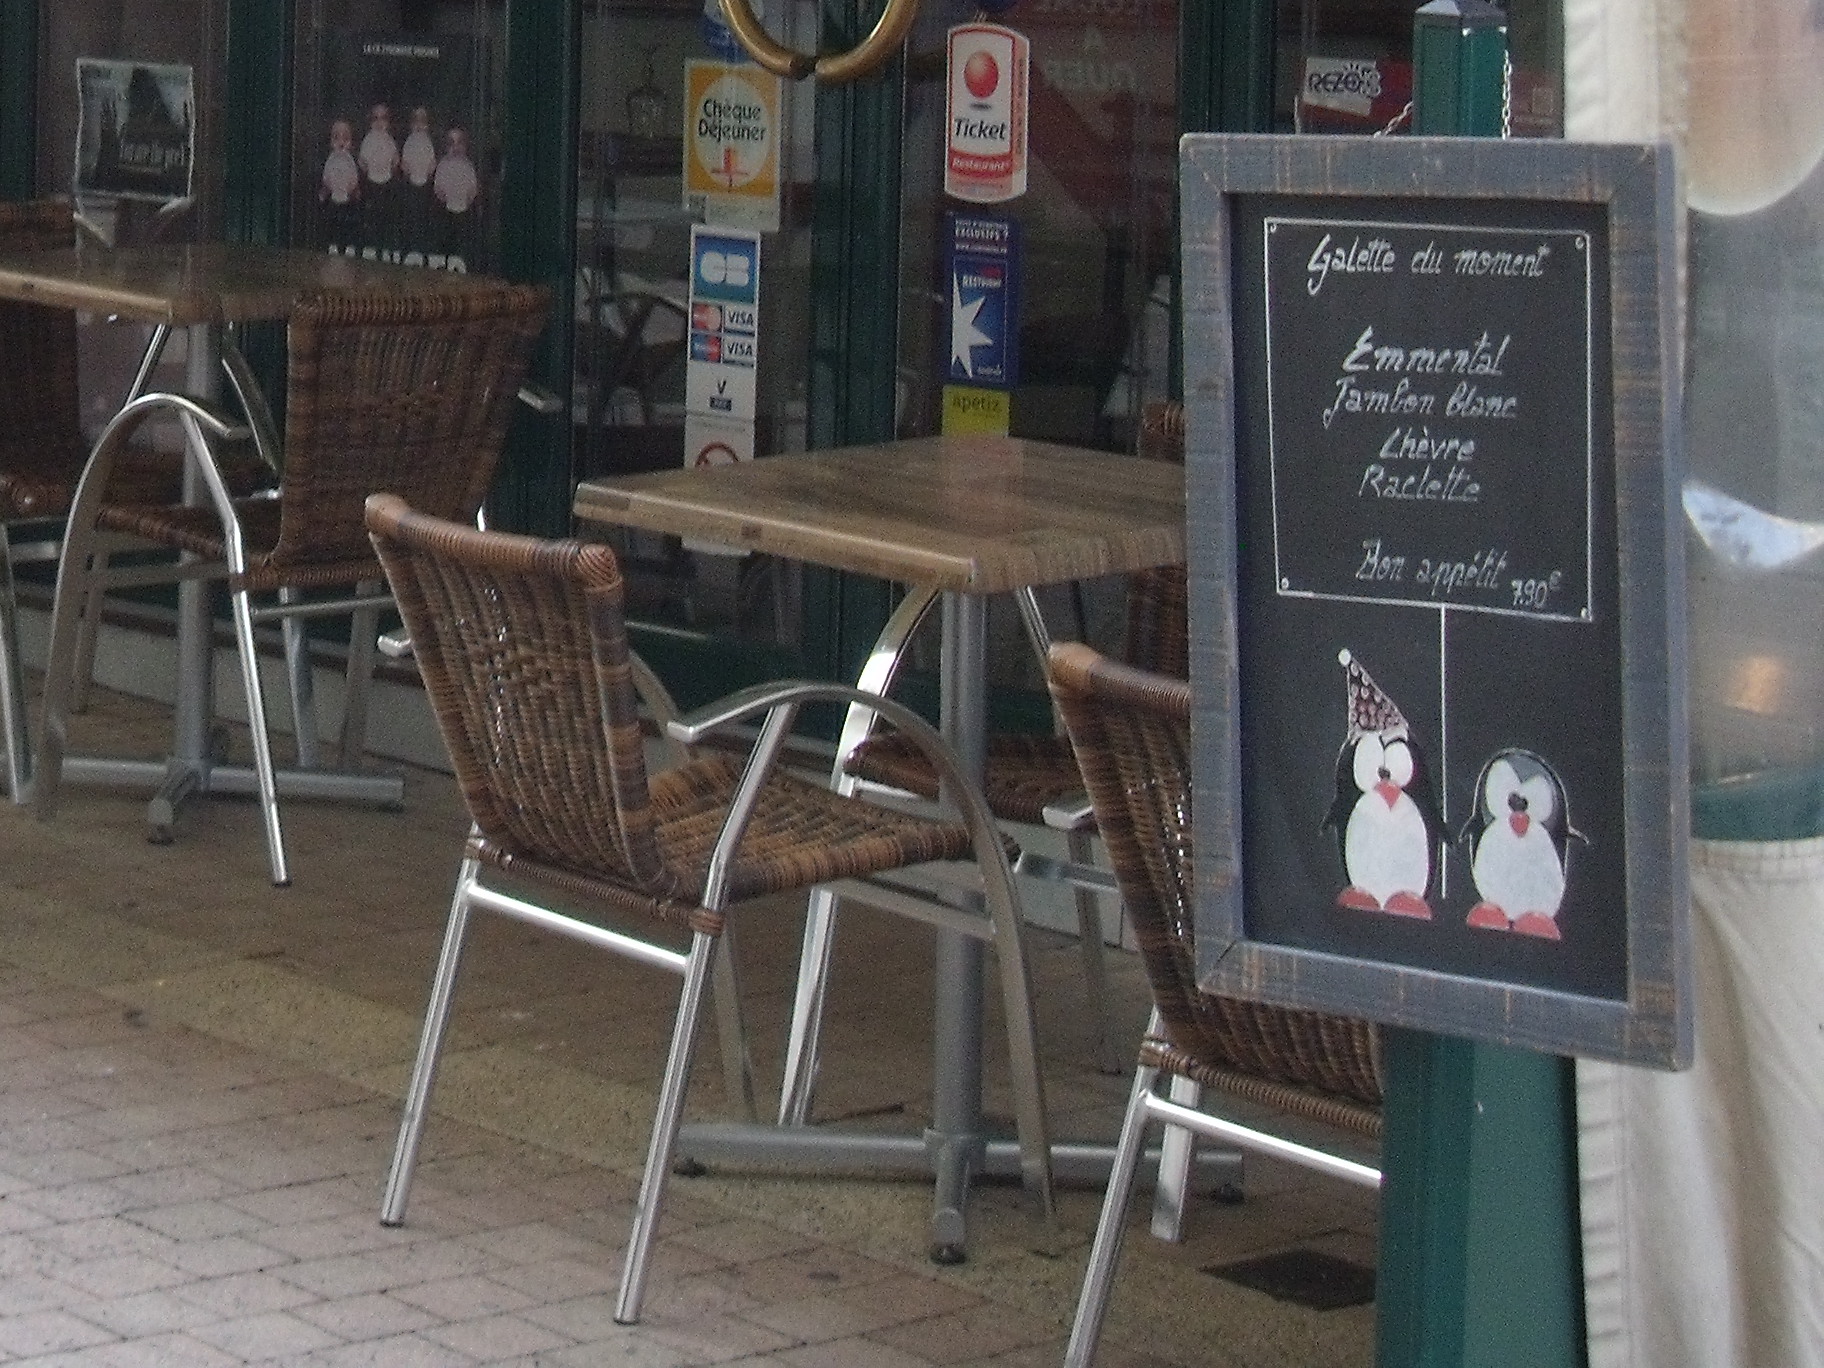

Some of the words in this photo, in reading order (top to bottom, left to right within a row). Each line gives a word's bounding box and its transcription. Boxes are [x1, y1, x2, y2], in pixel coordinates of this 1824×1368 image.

[704, 99, 761, 124] Chèque
[699, 119, 766, 143] Déjeuner
[955, 117, 1006, 141] Ticket
[1307, 234, 1395, 296] Galette
[1411, 241, 1443, 275] du
[1455, 243, 1552, 278] moment
[728, 311, 754, 327] VISA
[727, 341, 753, 356] VISA
[1342, 326, 1512, 376] Emmental
[1323, 377, 1435, 429] Jambon
[1359, 464, 1480, 502] Raclette
[1416, 547, 1509, 607] appétit
